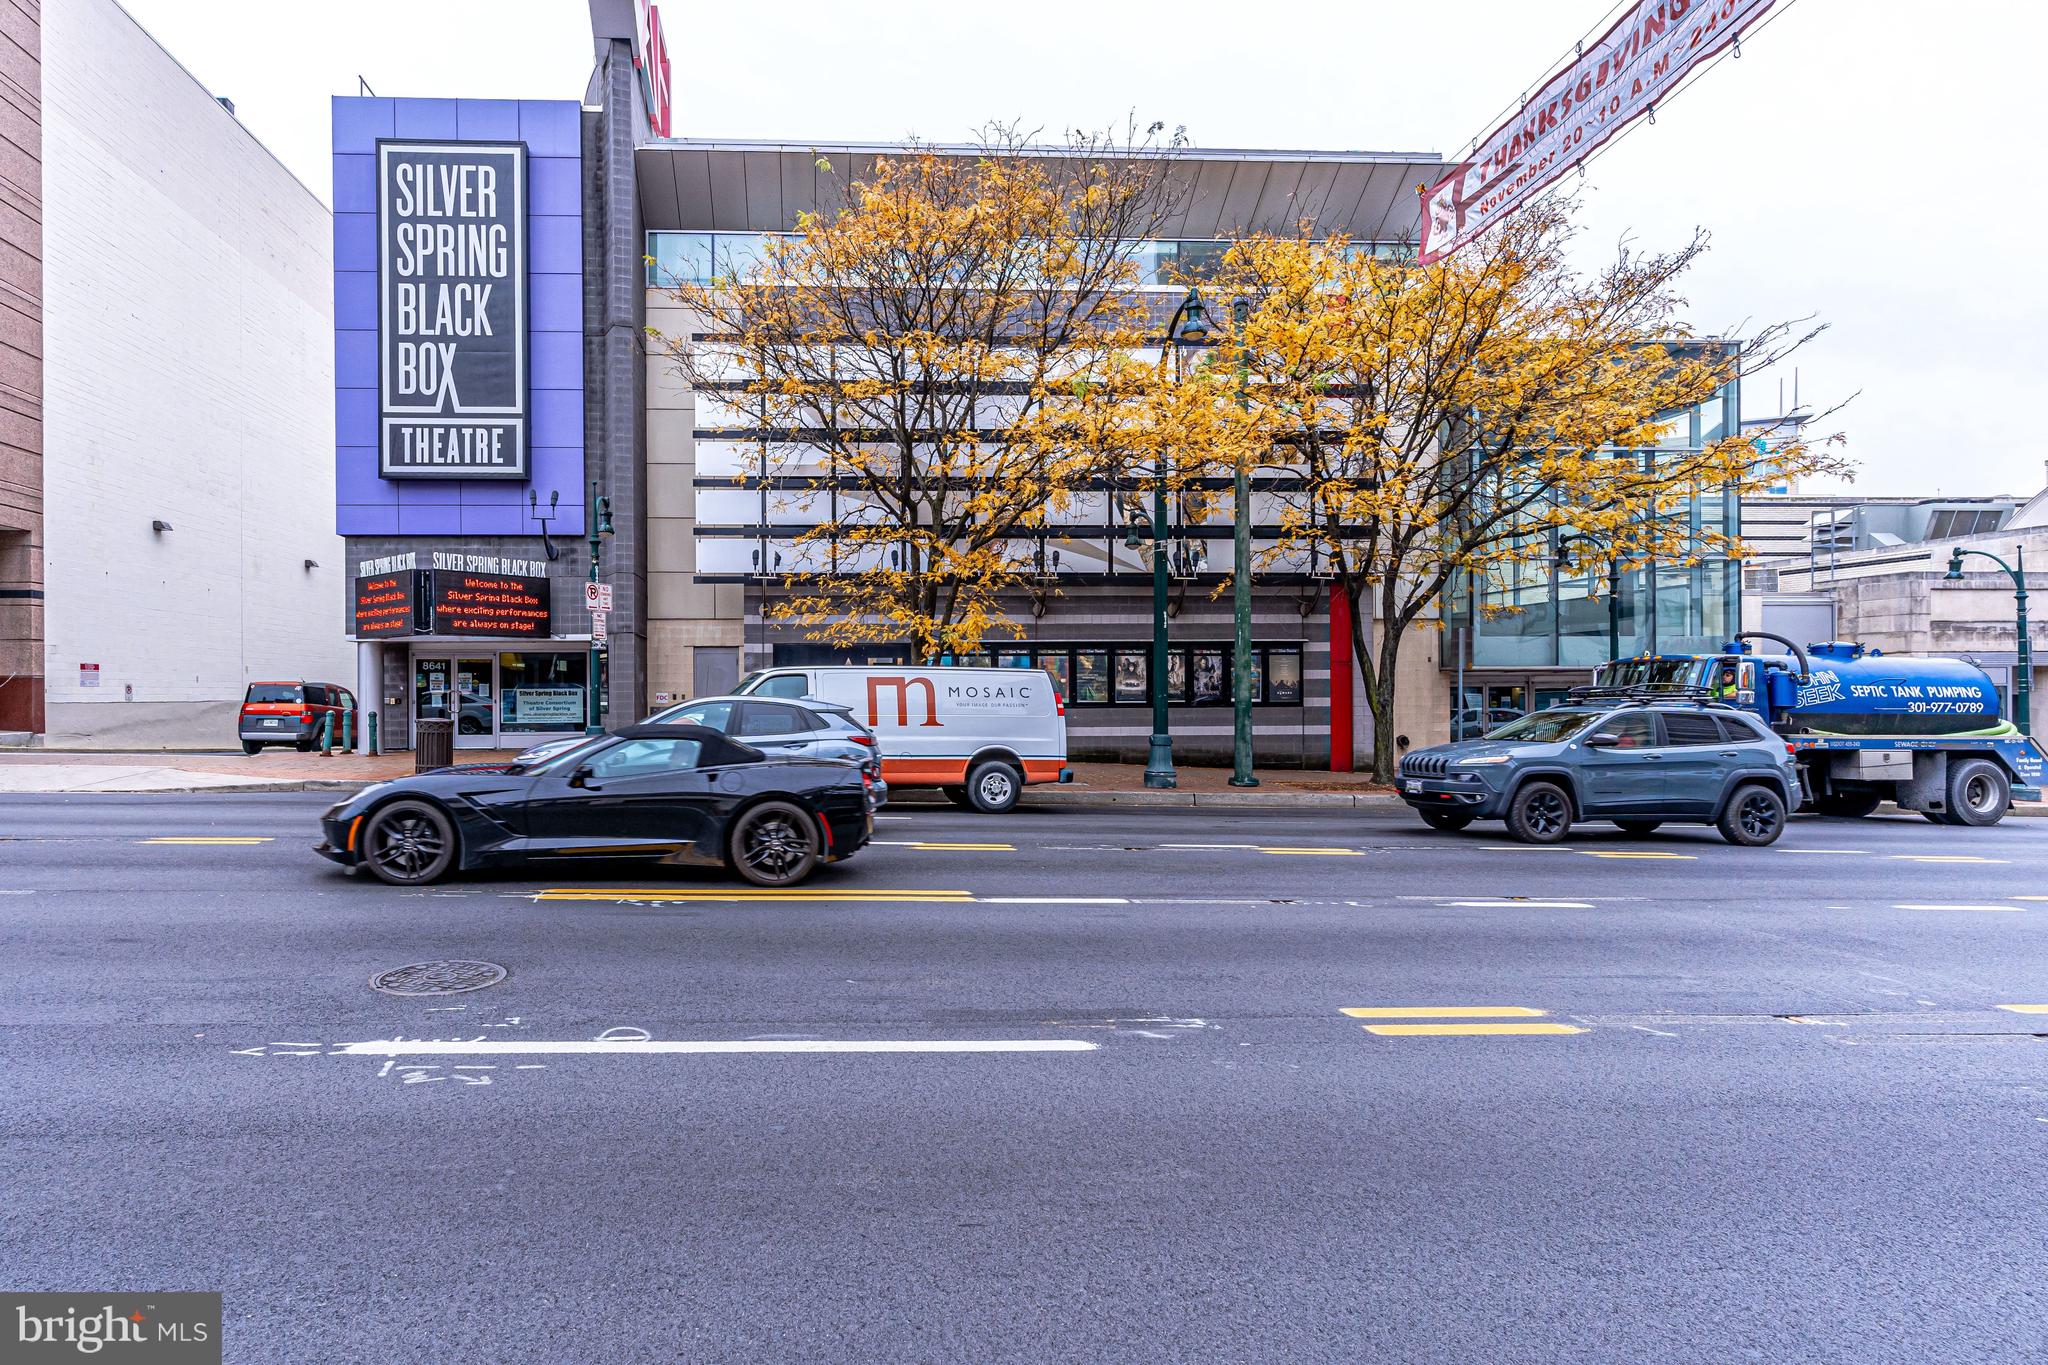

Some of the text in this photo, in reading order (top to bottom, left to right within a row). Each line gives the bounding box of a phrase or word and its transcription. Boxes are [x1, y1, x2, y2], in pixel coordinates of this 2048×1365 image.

[1480, 0, 1691, 184] THANKSGIVING
[396, 163, 497, 218] SILVER
[1480, 151, 1555, 216] November
[396, 223, 508, 278] SPRING
[398, 283, 493, 337] BLACK
[398, 342, 458, 412] BOX
[401, 427, 504, 464] THEATRE
[433, 552, 546, 578] SILVER SPRING BLACK BOX
[465, 578, 523, 590] Welcome to the
[448, 591, 538, 604] Silver Spring Black Box
[437, 604, 548, 618] where exciting performances
[470, 619, 497, 629] always
[500, 621, 509, 629] on
[511, 621, 535, 631] stage!
[422, 661, 446, 670] 8641
[949, 687, 1030, 698] MOSAIC
[1850, 684, 1982, 699] SEPTIC TANK PUMPING
[1907, 701, 1984, 713] 301-977-0789
